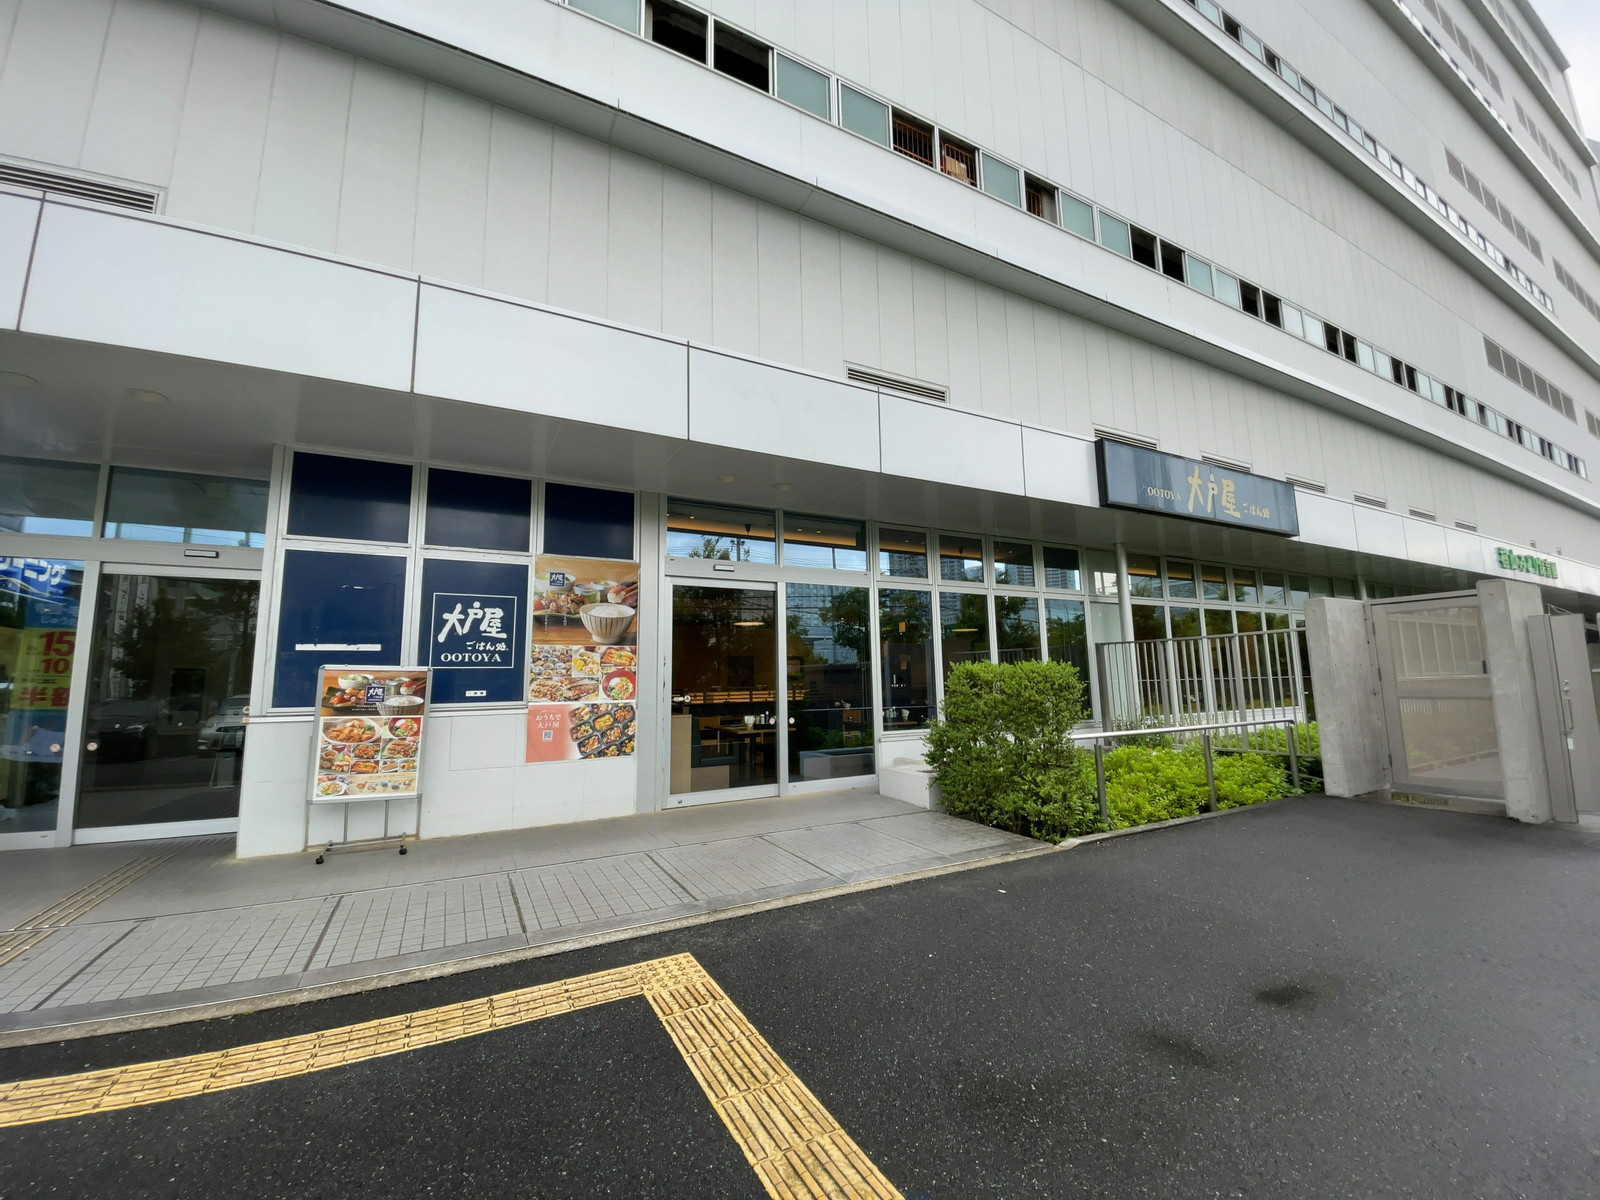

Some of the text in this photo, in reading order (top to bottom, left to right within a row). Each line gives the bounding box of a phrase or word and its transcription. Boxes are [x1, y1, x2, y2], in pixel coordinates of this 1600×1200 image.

[1147, 487, 1182, 501] OOTOYA
[1187, 464, 1241, 518] 大戸屋
[437, 601, 507, 643] 大戸屋
[40, 631, 76, 656] 15
[440, 652, 502, 662] OOTOYA
[42, 658, 70, 675] 10
[537, 721, 560, 729] 大戸屋
